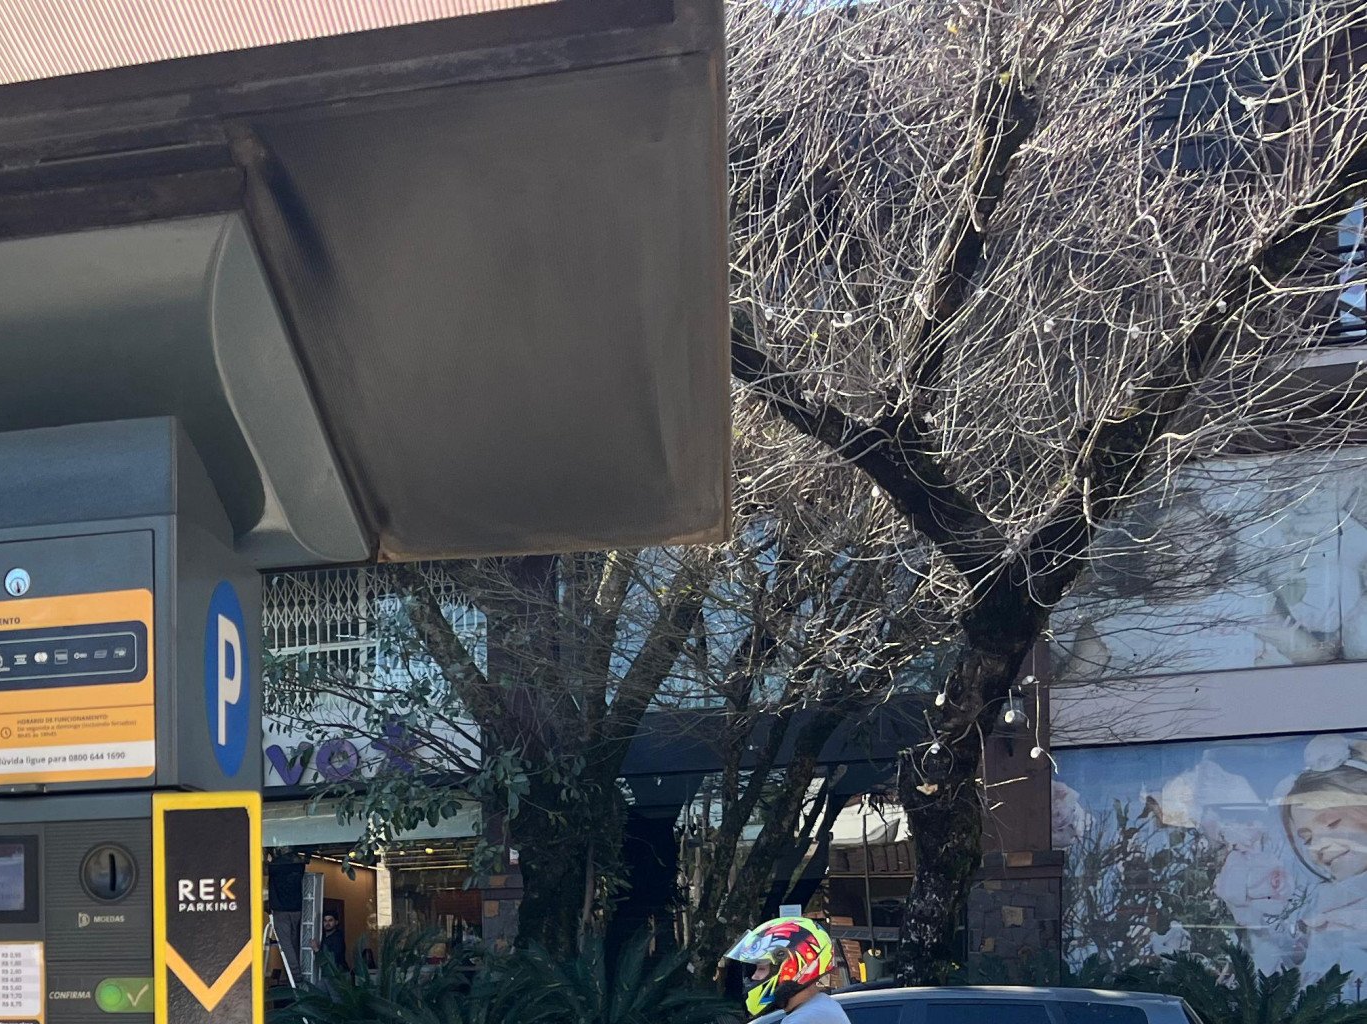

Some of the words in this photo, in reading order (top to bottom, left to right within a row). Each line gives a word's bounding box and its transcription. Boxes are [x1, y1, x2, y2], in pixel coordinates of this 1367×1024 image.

[217, 613, 242, 746] P
[26, 755, 46, 766] ligue
[48, 755, 67, 764] para
[68, 754, 88, 762] 0800
[89, 752, 104, 761] 644
[107, 752, 125, 760] 1690
[178, 878, 236, 900] REK
[178, 901, 238, 912] PARKING
[93, 915, 125, 923] MOEDAS
[49, 990, 91, 1000] CONFIRMA
